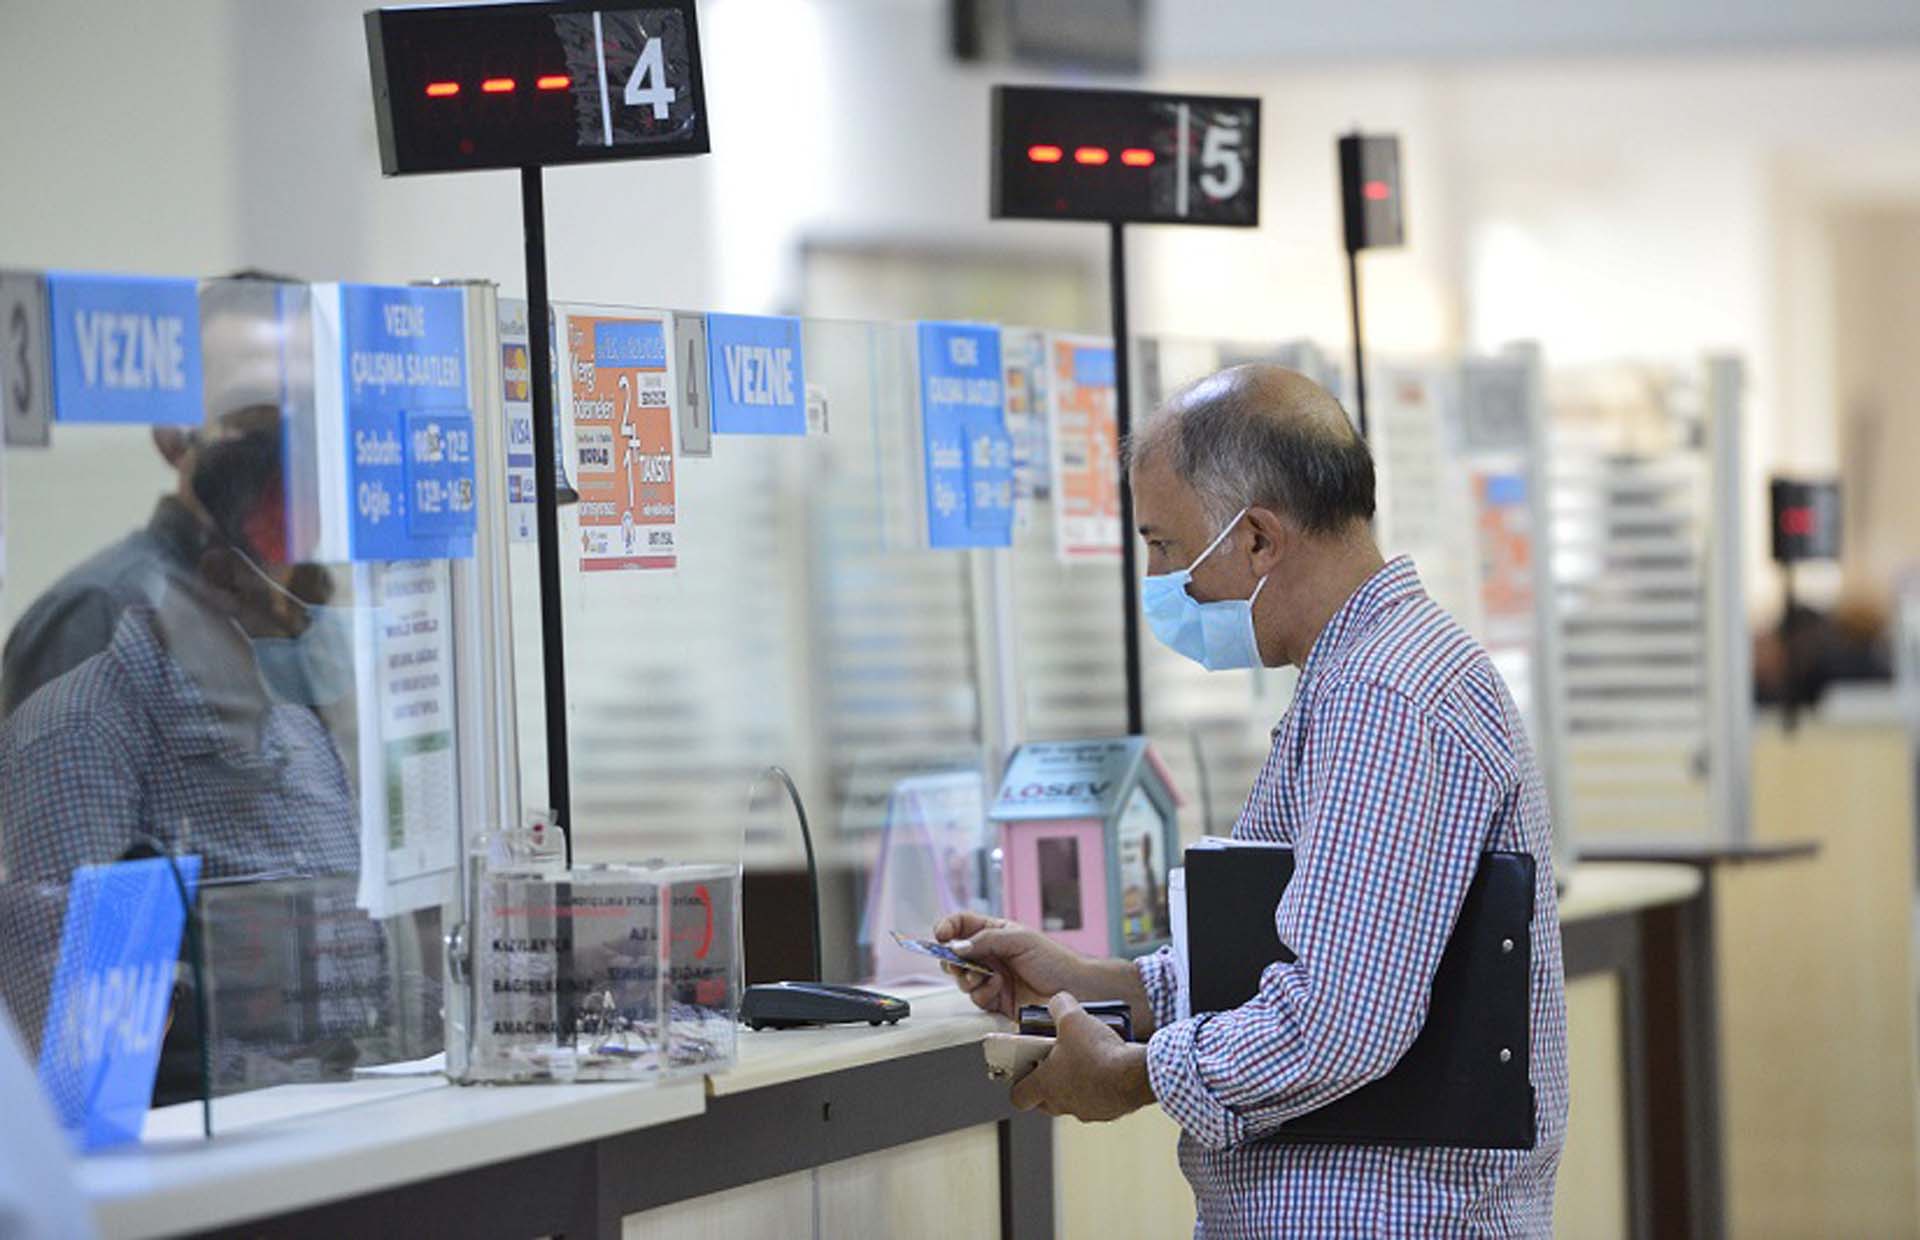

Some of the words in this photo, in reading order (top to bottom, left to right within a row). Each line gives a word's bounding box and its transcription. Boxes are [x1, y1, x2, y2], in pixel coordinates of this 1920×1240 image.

[624, 36, 676, 120] 4
[1200, 124, 1245, 200] 5
[10, 300, 32, 416] 3
[74, 310, 187, 391] VEZNE
[383, 304, 425, 336] VEZNE
[687, 339, 700, 429] 4
[723, 344, 796, 406] VEZNE
